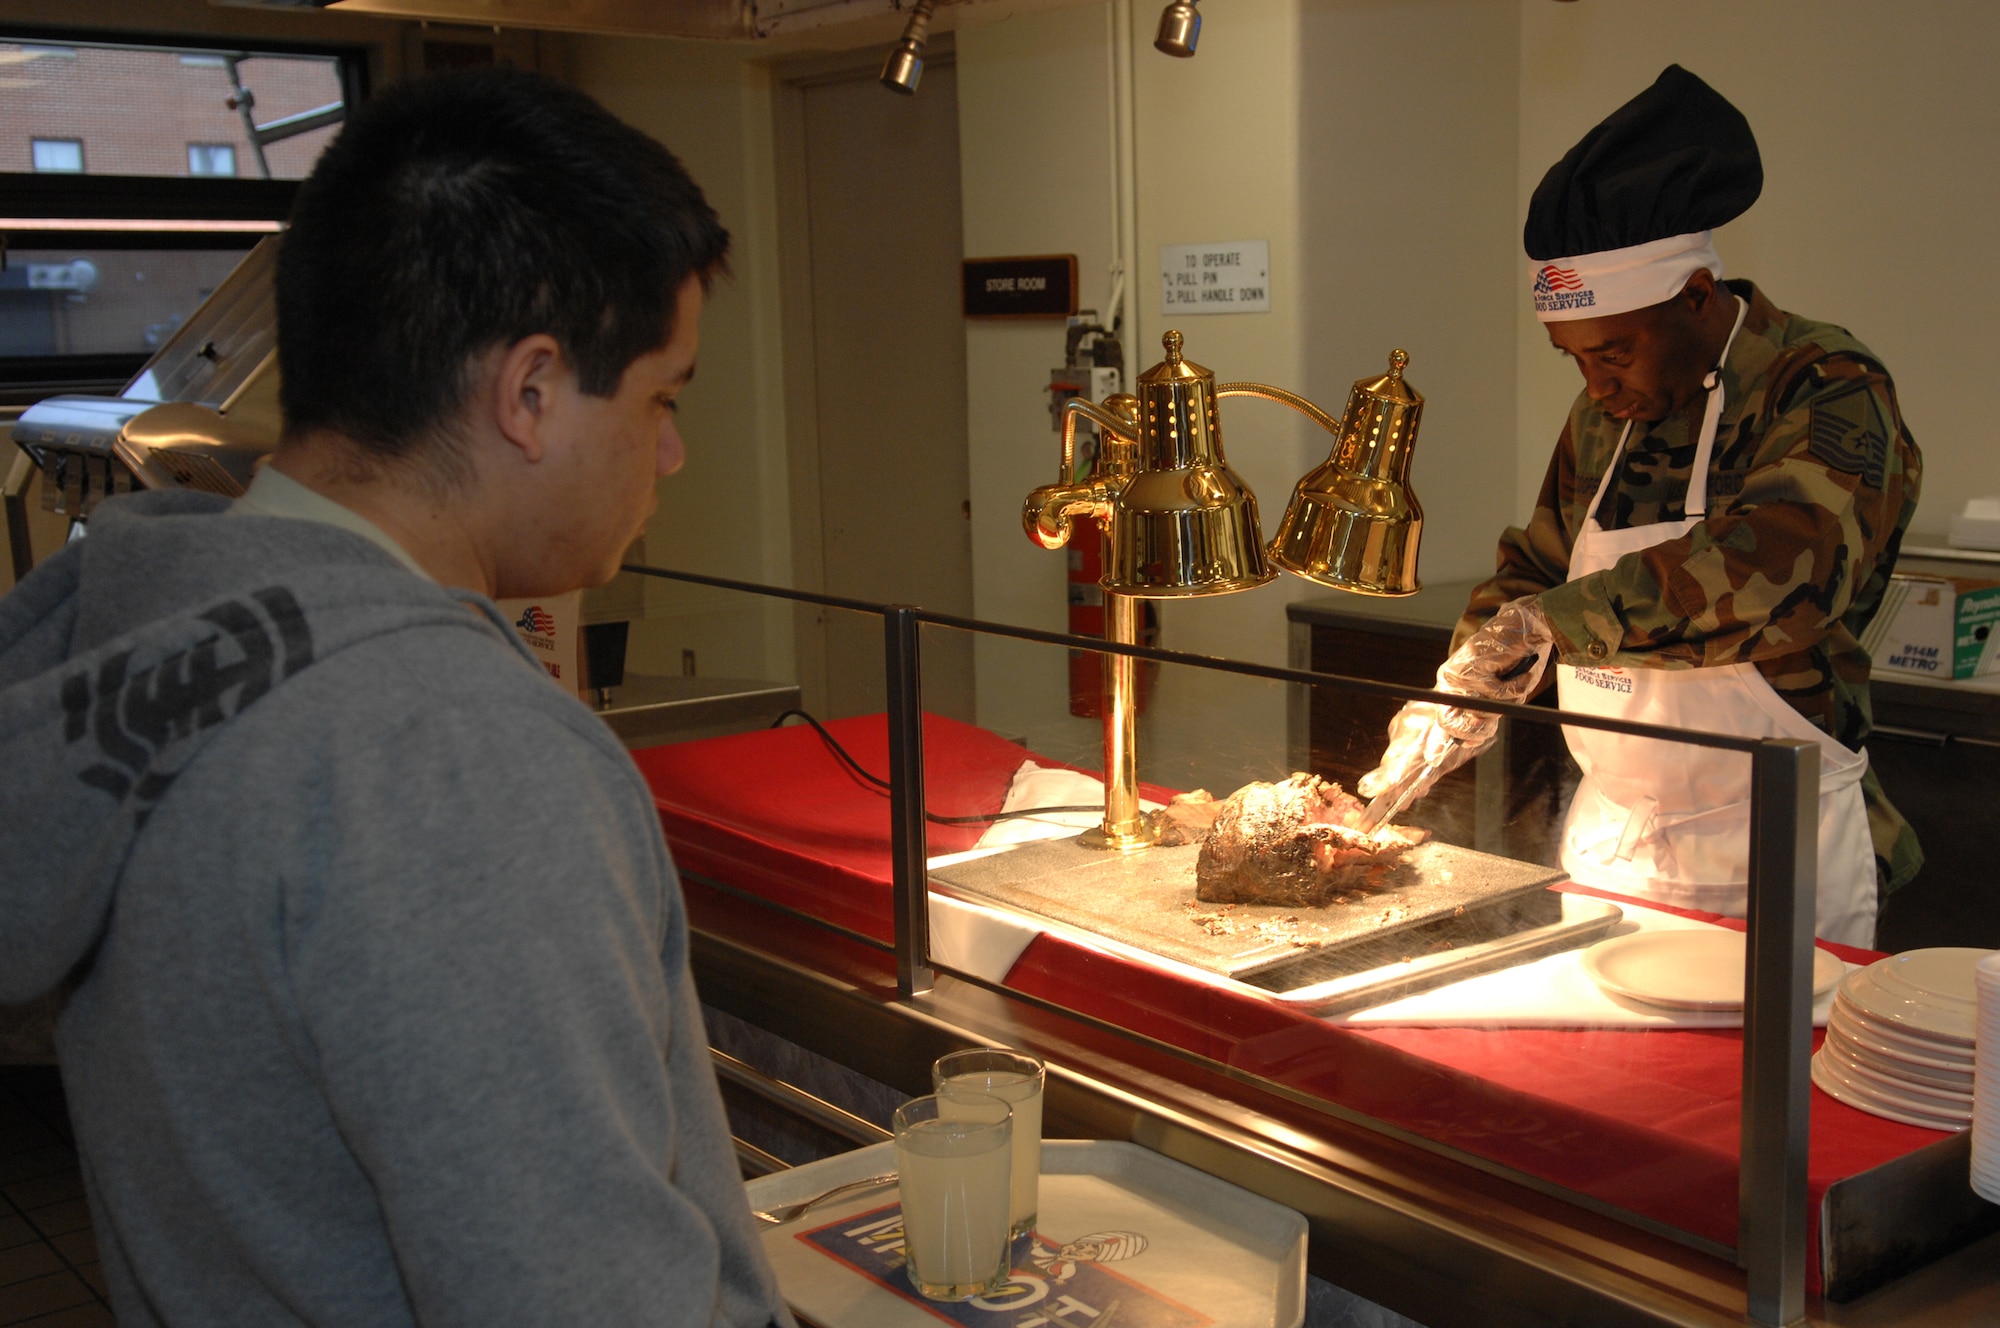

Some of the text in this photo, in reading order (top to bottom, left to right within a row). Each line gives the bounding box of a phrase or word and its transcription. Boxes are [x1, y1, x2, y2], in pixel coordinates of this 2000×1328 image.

[1185, 252, 1241, 268] TO OPERATE
[985, 277, 1046, 292] STORE ROOM
[1176, 272, 1198, 286] PULL
[1203, 271, 1218, 285] PIN
[1177, 290, 1197, 303] PULL
[1202, 288, 1234, 302] HANDLE
[1240, 287, 1264, 301] DOWN
[1535, 297, 1596, 311] OOD SERVICE
[1904, 645, 1939, 658] 914M
[1889, 655, 1938, 671] METRO
[1575, 671, 1632, 693] FOOD SERVICE
